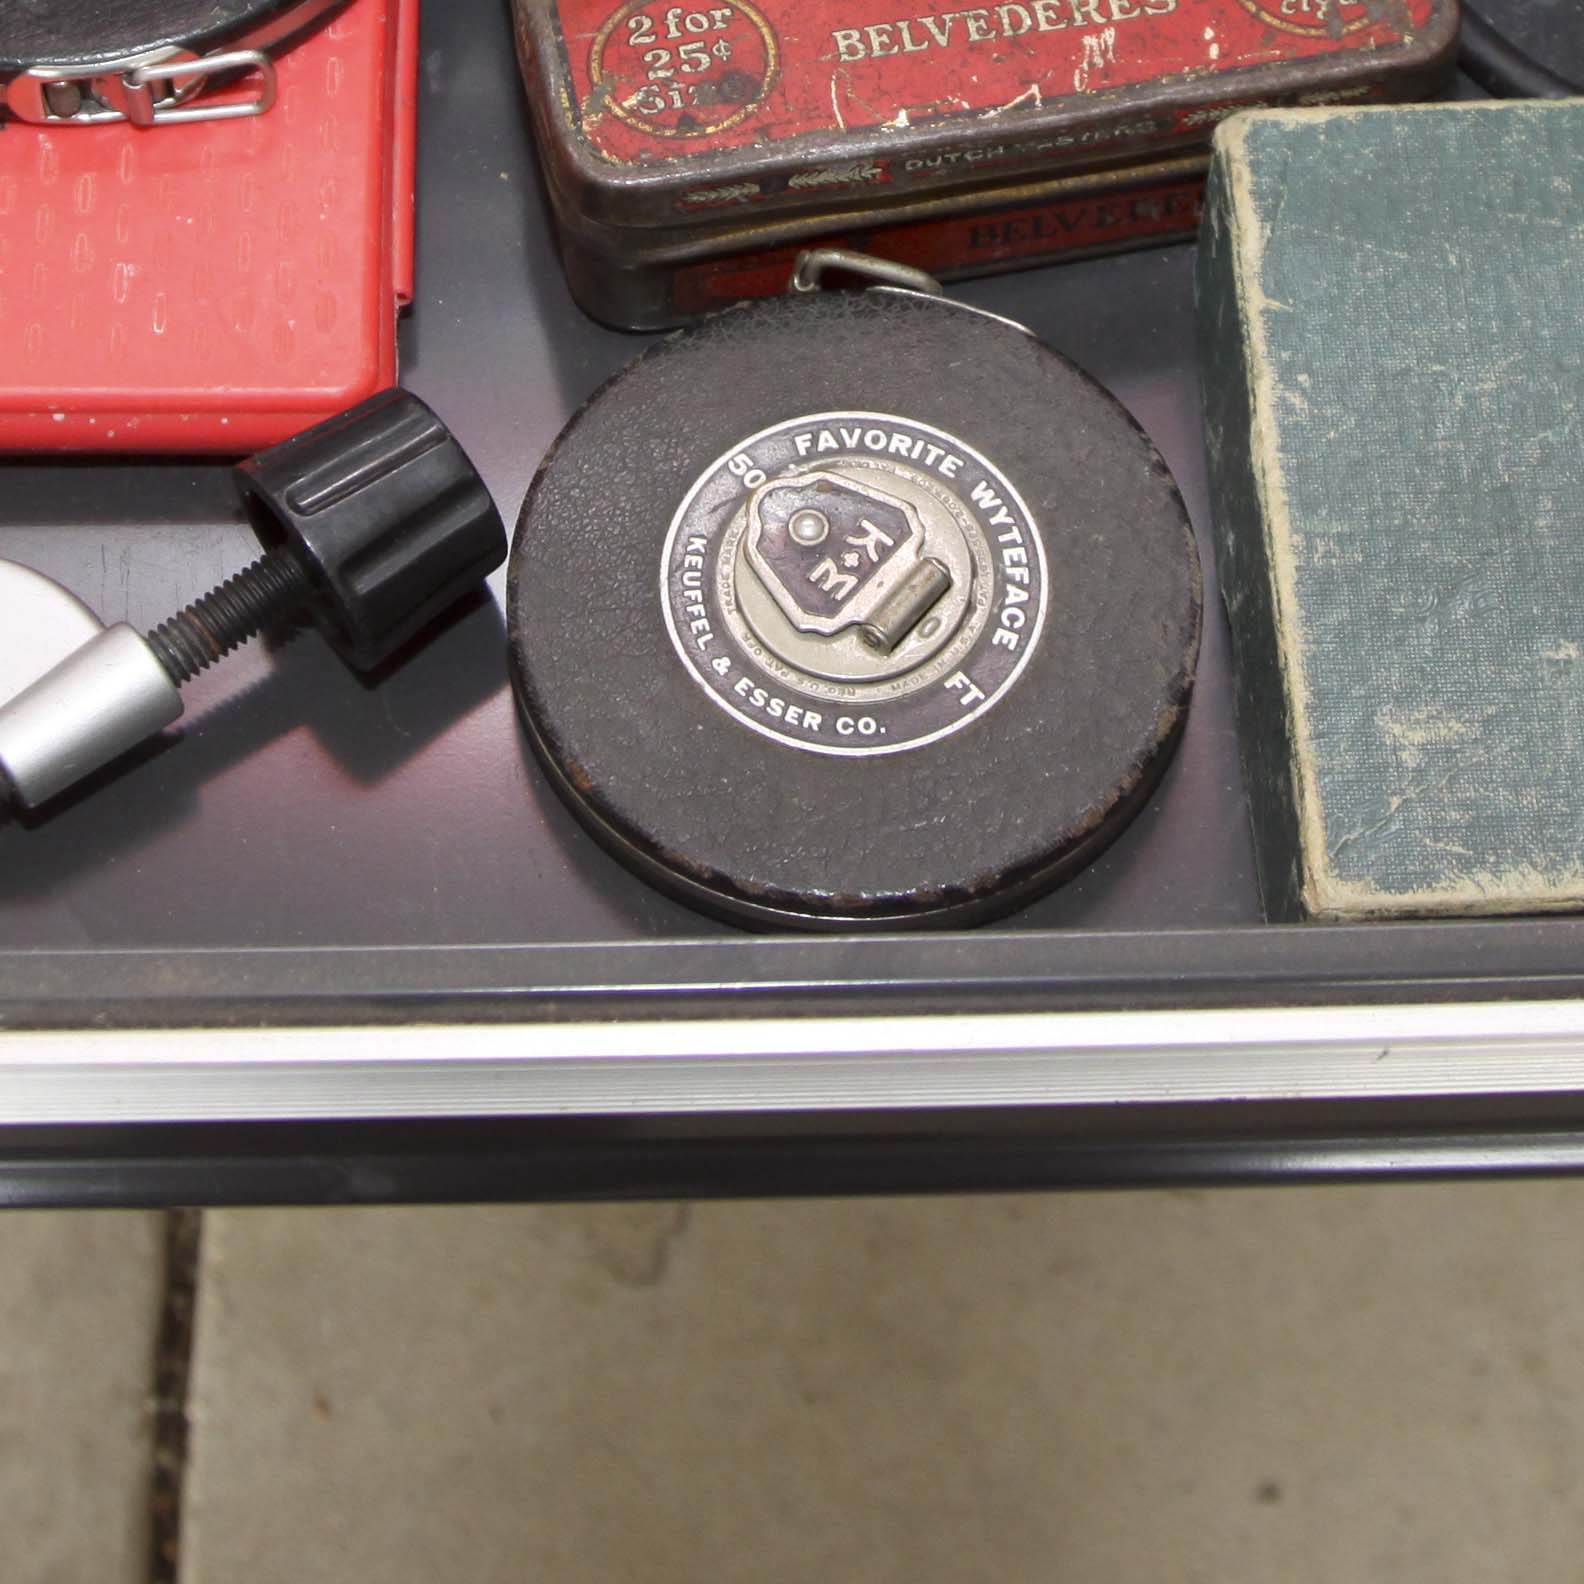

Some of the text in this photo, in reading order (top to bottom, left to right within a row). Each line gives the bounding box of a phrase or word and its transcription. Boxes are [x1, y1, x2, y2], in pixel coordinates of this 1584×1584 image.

[627, 6, 733, 46] 2 for
[728, 452, 768, 489] 50
[793, 427, 1030, 651] FAVORITE WYTEFACE
[681, 535, 887, 736] KEUFFEL & ESSER CO.
[943, 671, 986, 708] FT
